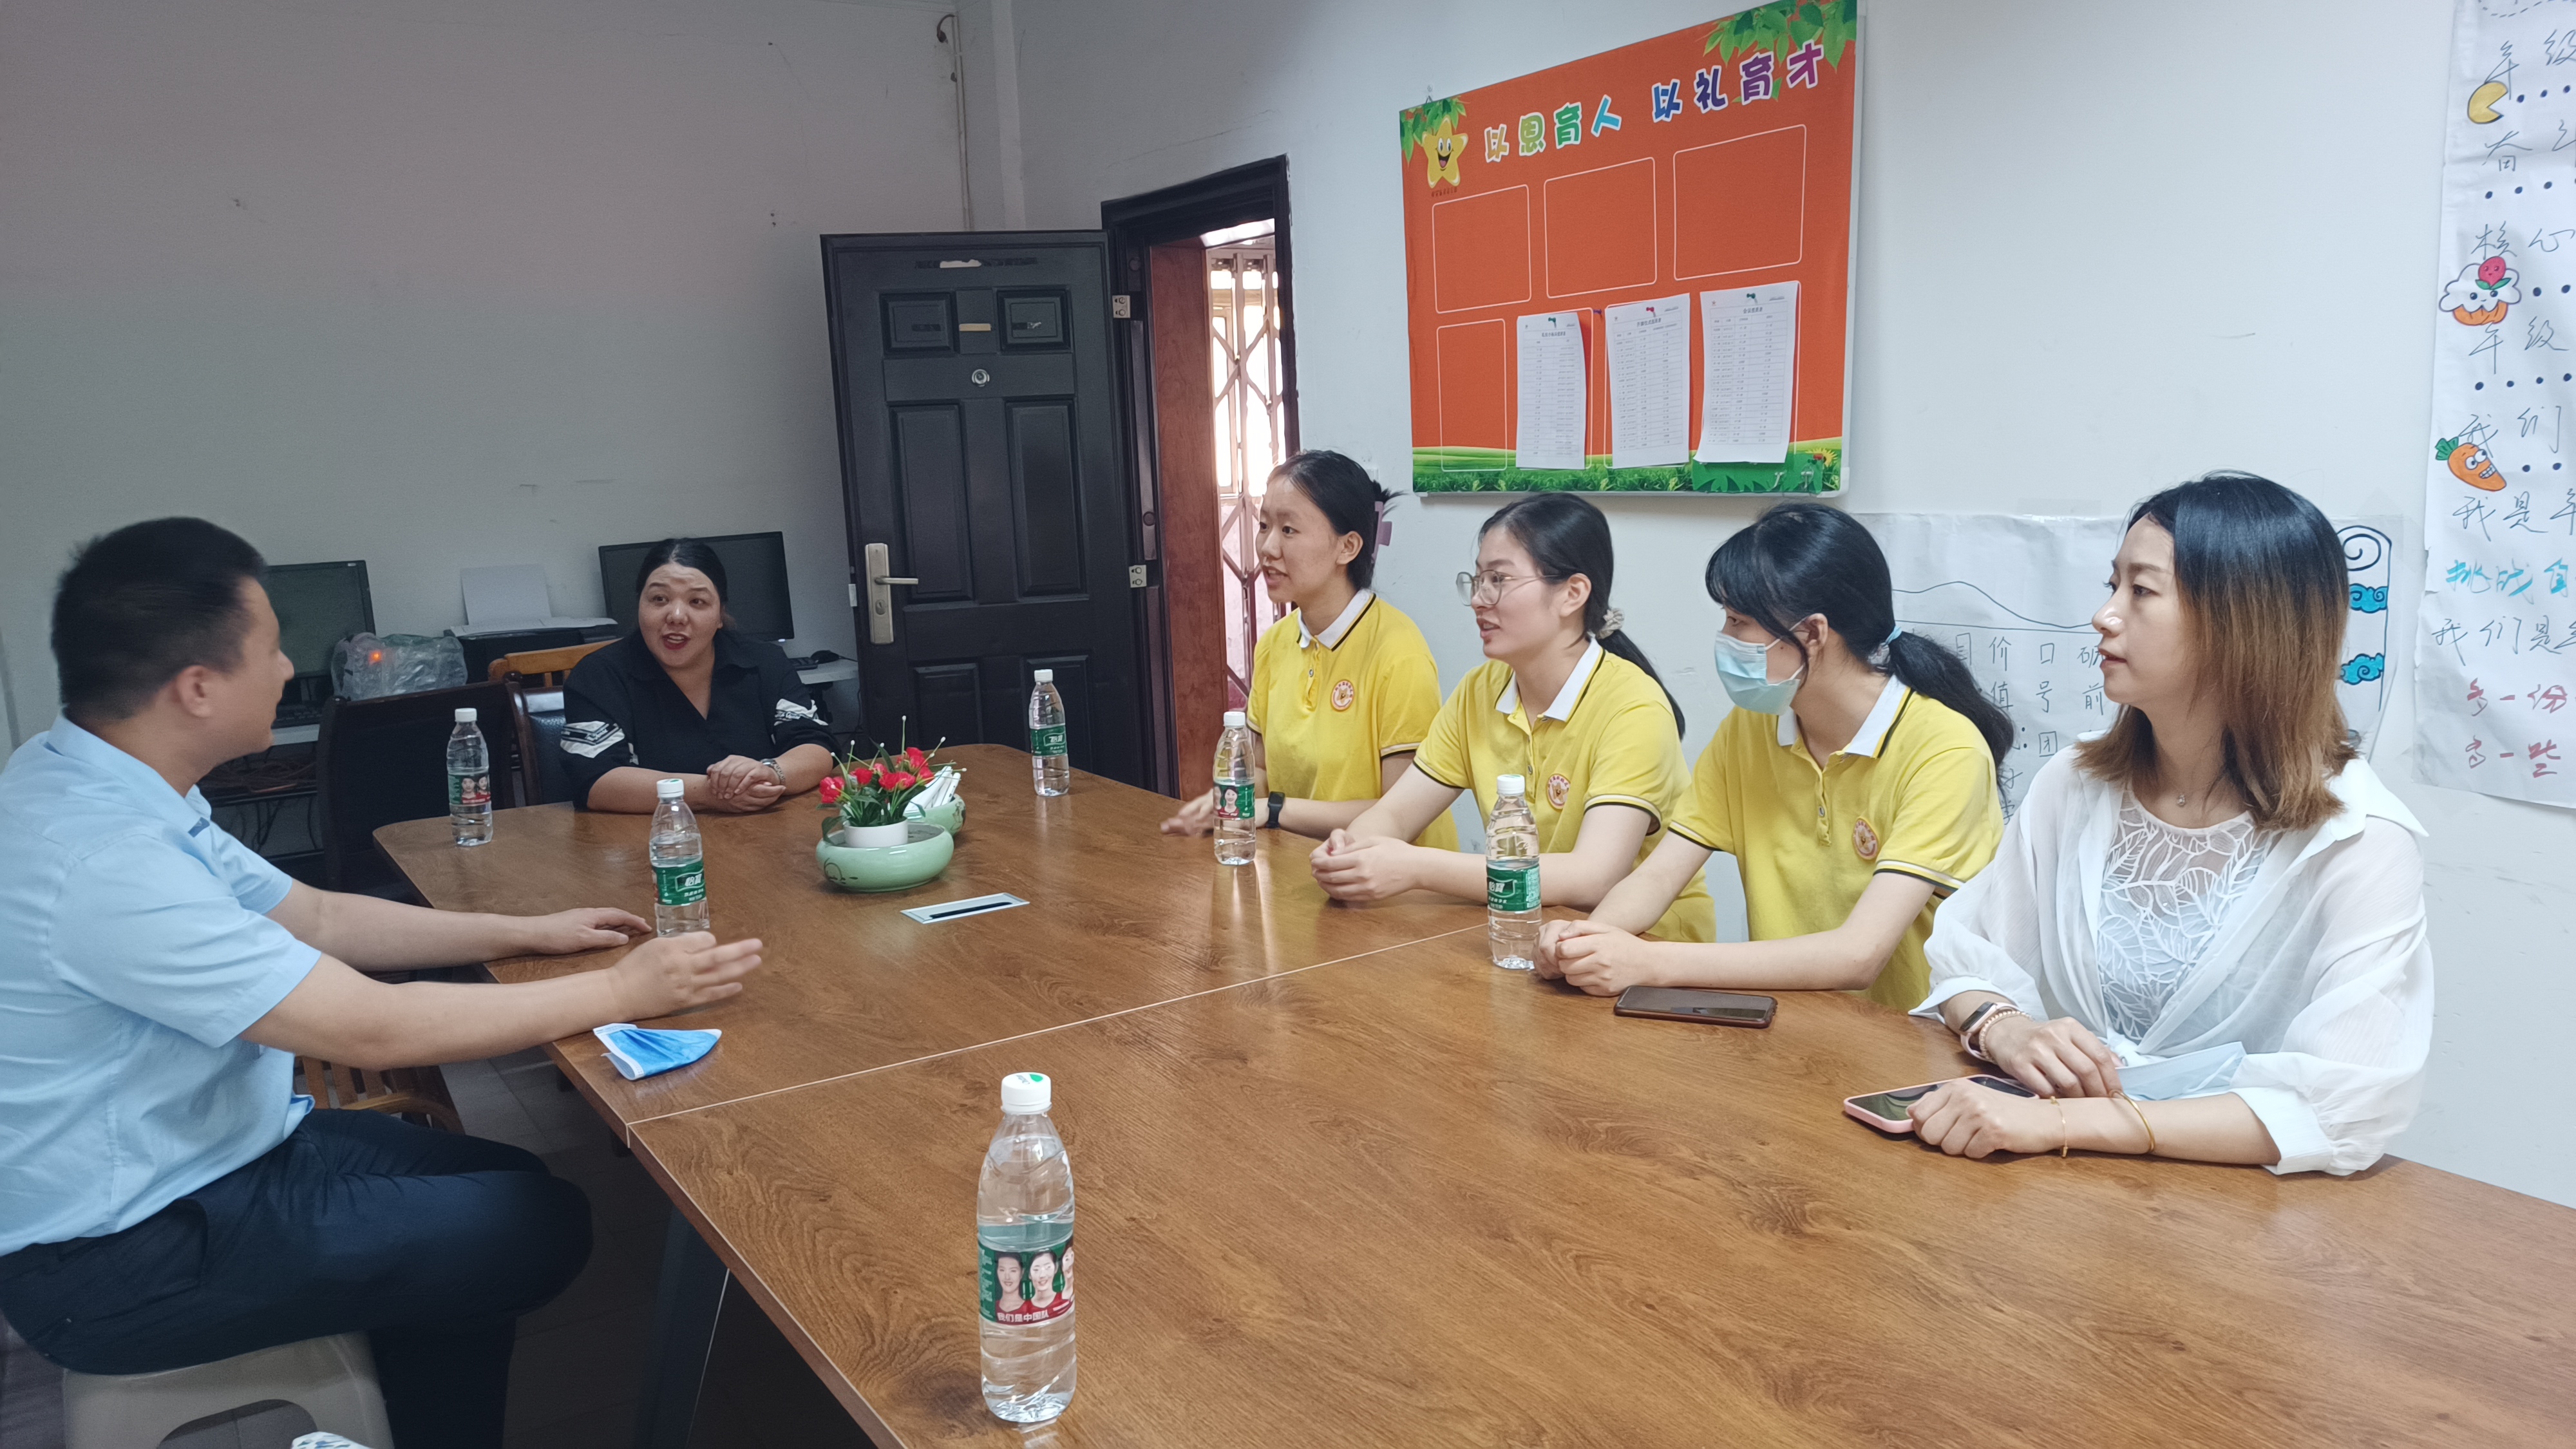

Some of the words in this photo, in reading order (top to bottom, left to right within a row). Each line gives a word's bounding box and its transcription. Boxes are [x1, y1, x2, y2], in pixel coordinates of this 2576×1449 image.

[1485, 95, 1621, 163] 以恩育人
[1652, 39, 1824, 122] 以礼育才
[2468, 316, 2570, 374] 年级
[2458, 406, 2561, 458] 我们
[997, 1309, 1049, 1323] 我们是中国队
